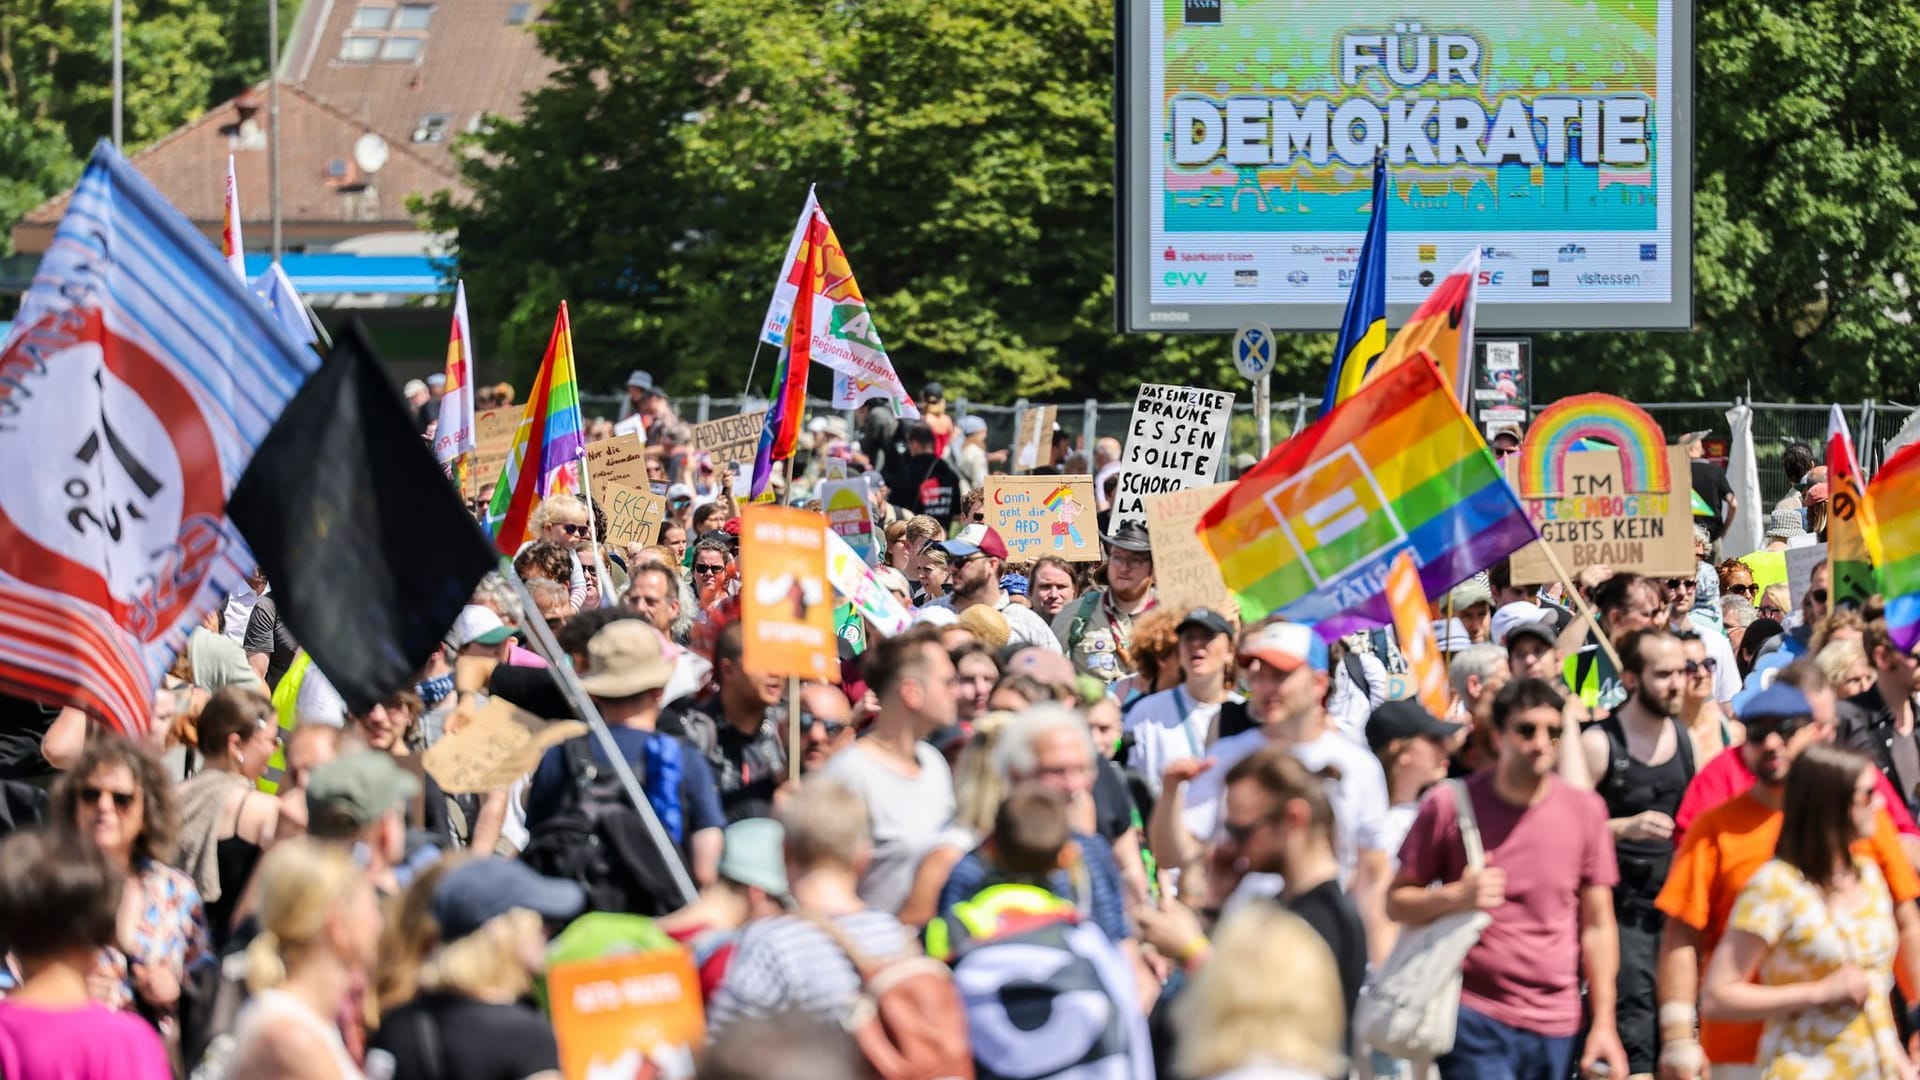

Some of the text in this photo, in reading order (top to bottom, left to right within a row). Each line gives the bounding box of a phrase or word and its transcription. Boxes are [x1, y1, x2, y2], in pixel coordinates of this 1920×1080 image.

[1343, 23, 1480, 86] FÜR
[1175, 98, 1649, 166] DEMOKRATIE
[1163, 271, 1207, 287] evv
[1576, 271, 1640, 286] visitessen
[1142, 386, 1225, 410] DAS EINZIGE
[1138, 399, 1211, 426] BRAUNE
[1134, 419, 1216, 450] ESSEN
[1132, 445, 1210, 476] SOLLTE
[994, 487, 1031, 505] Conni
[1572, 474, 1612, 495] IM
[613, 490, 653, 525] EKEL
[999, 508, 1046, 526] geht die
[1529, 495, 1669, 521] REGENBOGEN
[1541, 518, 1664, 542] GIBTS KEIN
[1573, 542, 1644, 566] BRAUN
